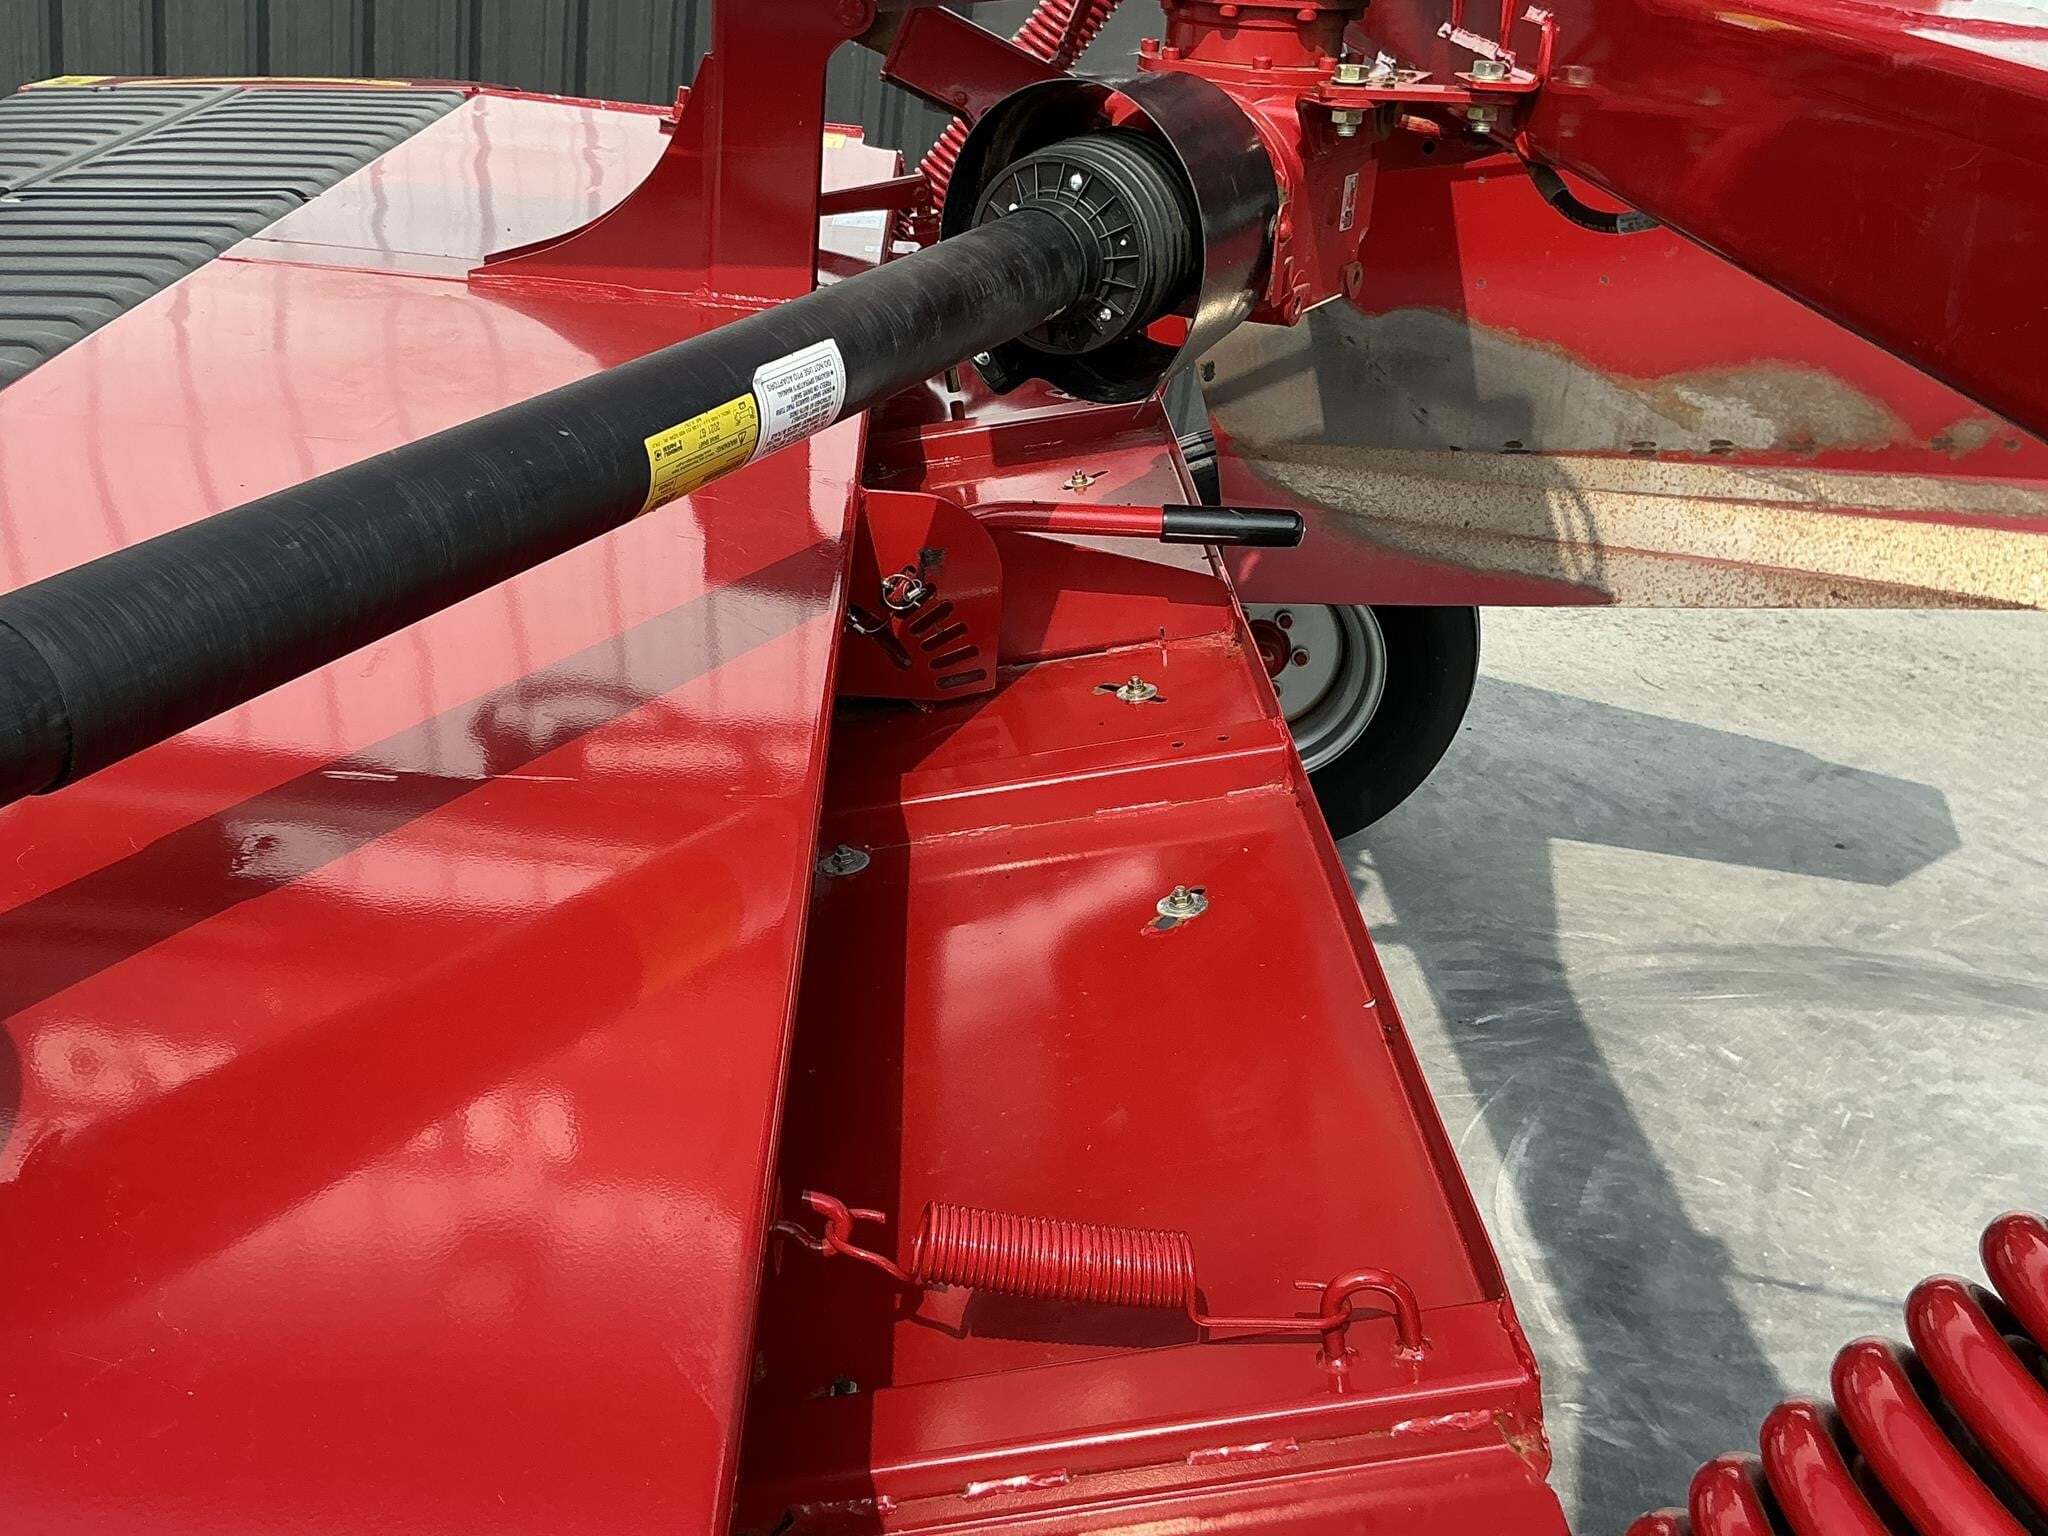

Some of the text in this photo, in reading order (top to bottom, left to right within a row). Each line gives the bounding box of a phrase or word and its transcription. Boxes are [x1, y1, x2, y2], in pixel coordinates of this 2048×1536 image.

[765, 358, 832, 392] DO NOT USE PTO ADAPTORS
